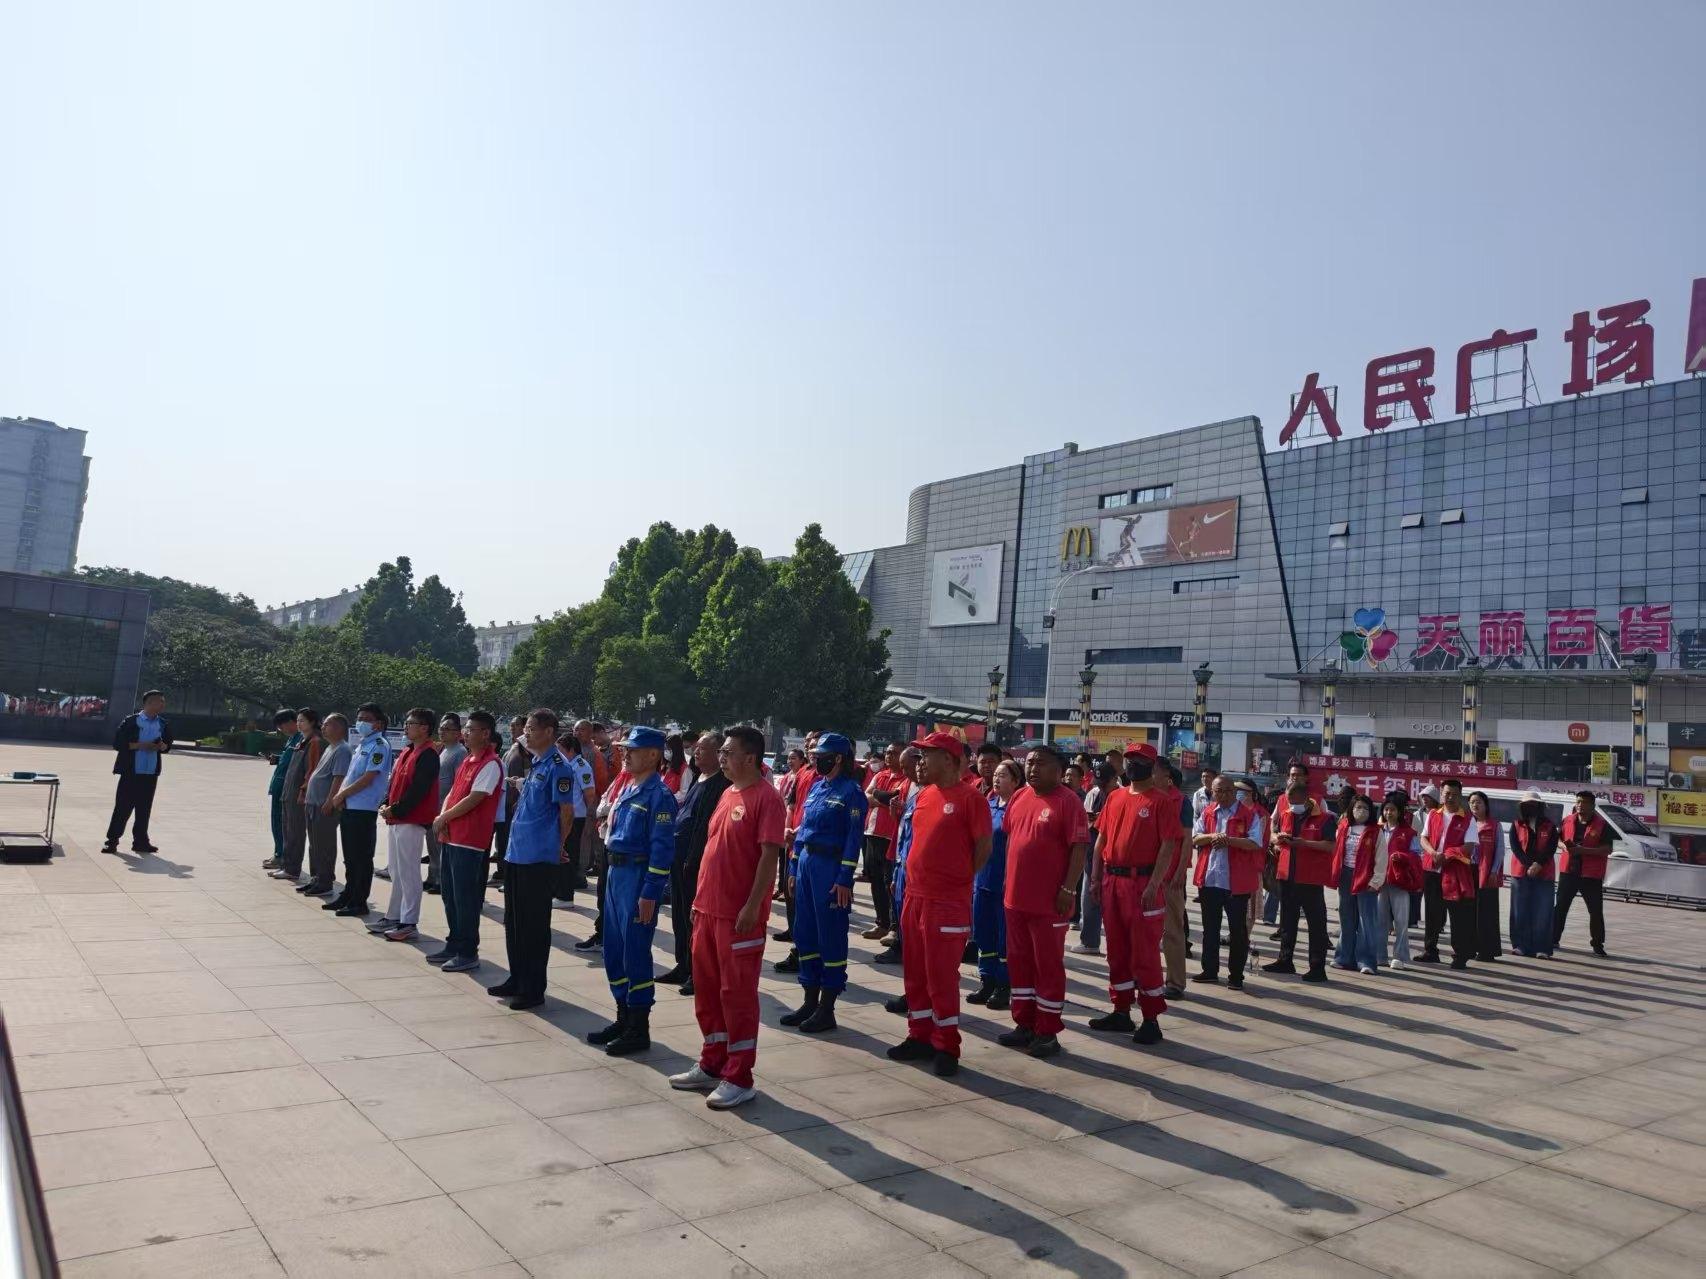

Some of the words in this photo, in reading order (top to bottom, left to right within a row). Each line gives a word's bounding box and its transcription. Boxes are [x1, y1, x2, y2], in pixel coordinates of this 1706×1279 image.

[1279, 299, 1655, 446] 人民广场
[1069, 711, 1129, 723] Mconald's
[1275, 716, 1315, 730] vivo
[1411, 721, 1456, 735] oppo
[1309, 756, 1326, 766] 饰品
[1355, 759, 1374, 770] 箱包
[1380, 760, 1399, 771] 礼品
[1404, 761, 1424, 773] 玩具
[1430, 763, 1451, 774] 水杯
[1457, 764, 1479, 775] 文体
[1485, 765, 1508, 777] 百货
[1664, 801, 1706, 816] 榴莲
